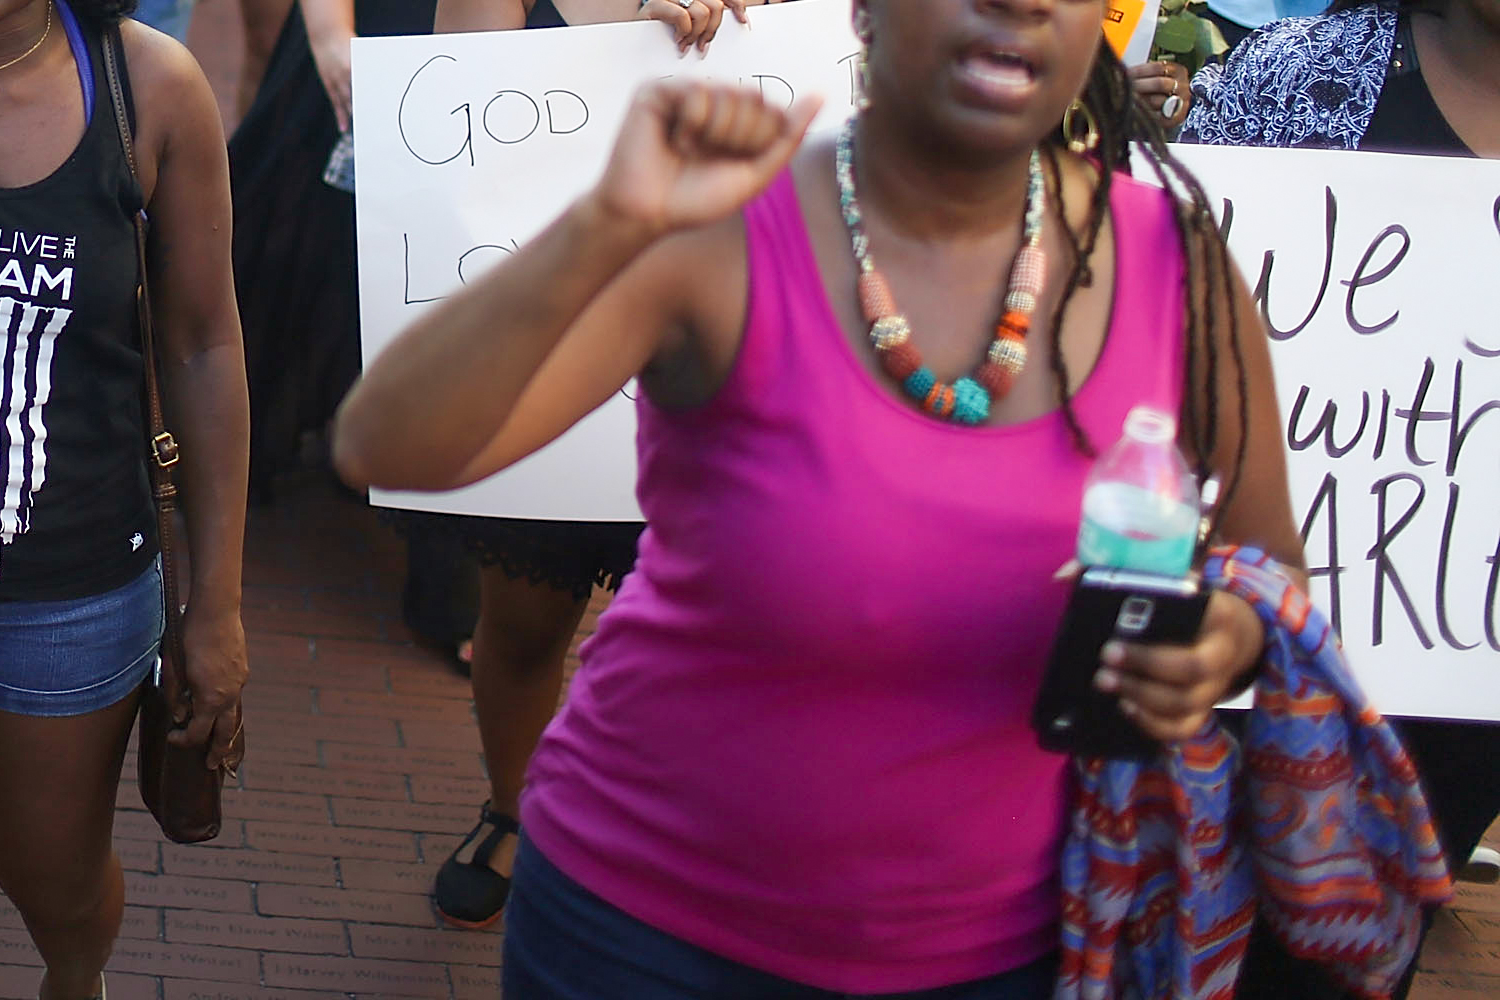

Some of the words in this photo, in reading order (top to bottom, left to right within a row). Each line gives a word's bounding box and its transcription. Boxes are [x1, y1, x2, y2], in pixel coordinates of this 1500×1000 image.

[398, 54, 590, 167] GOD
[62, 235, 77, 260] THE
[1287, 356, 1500, 477] with
